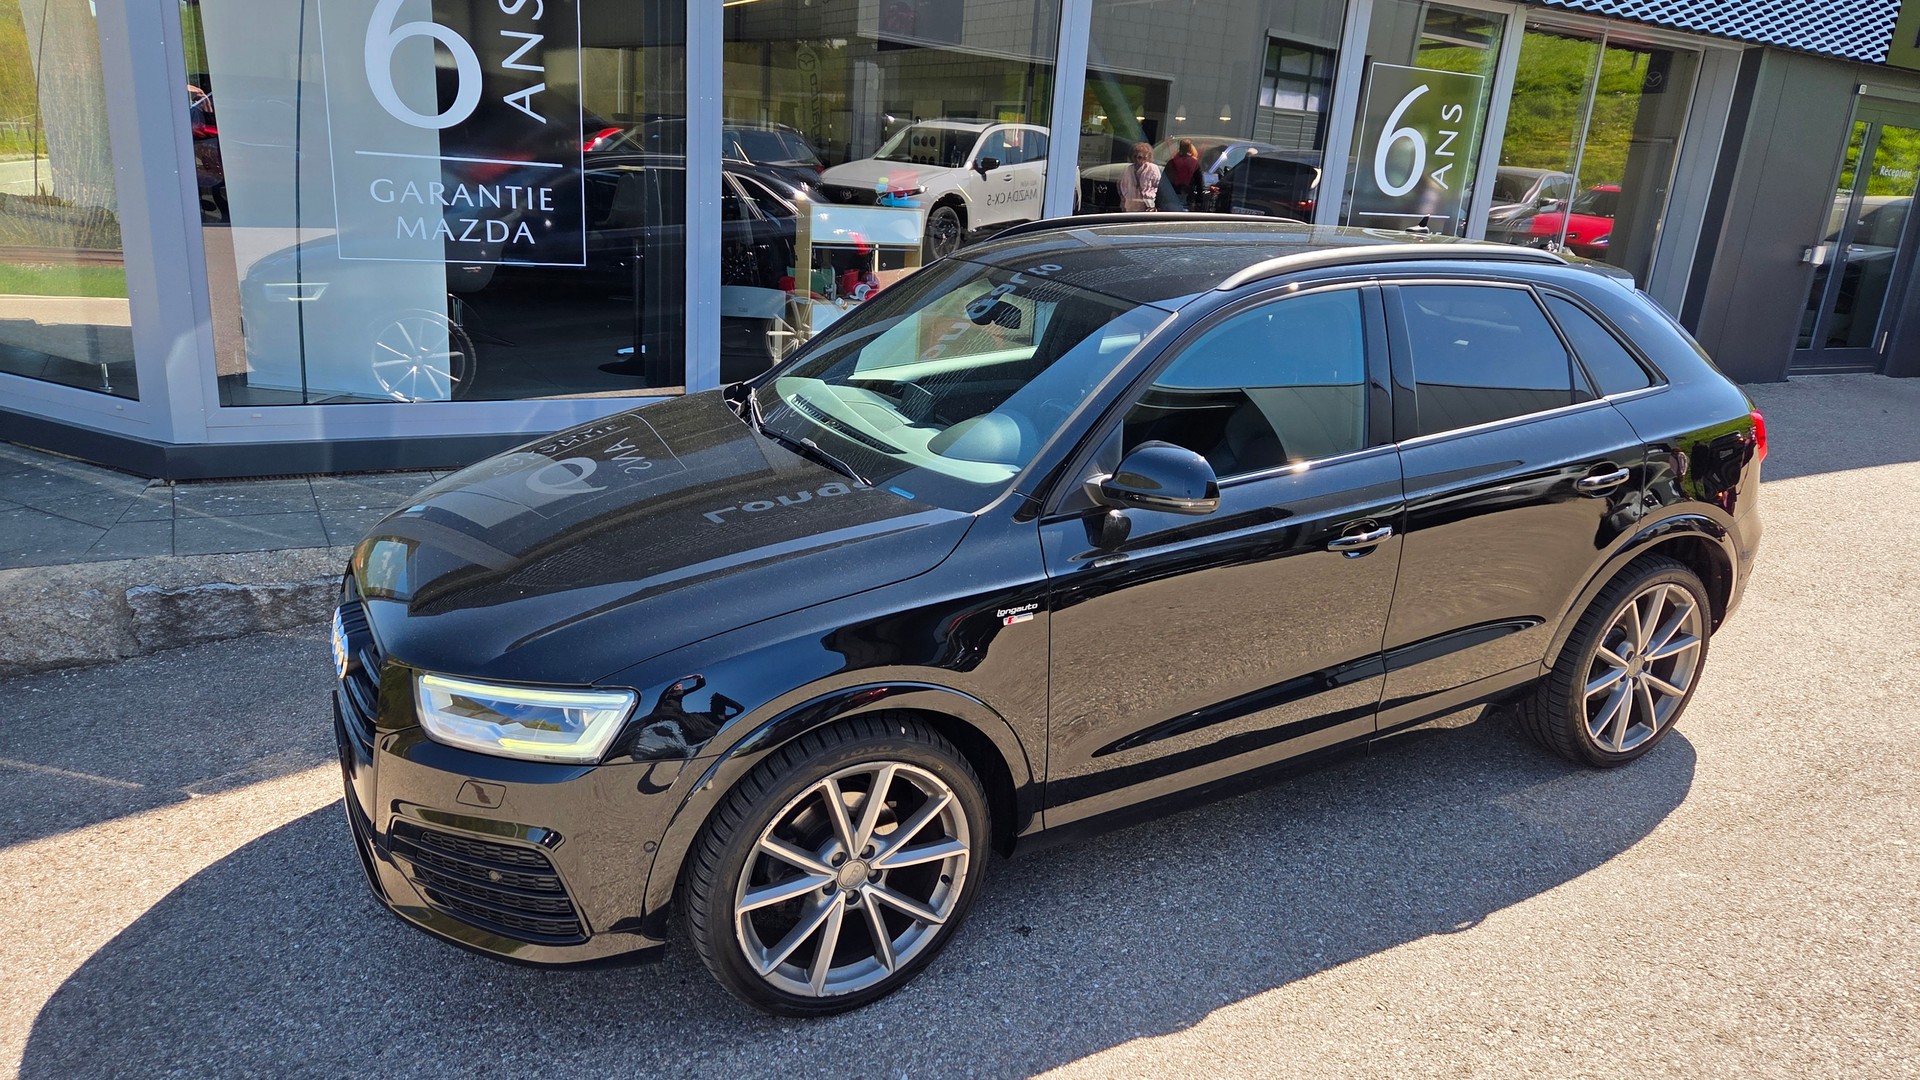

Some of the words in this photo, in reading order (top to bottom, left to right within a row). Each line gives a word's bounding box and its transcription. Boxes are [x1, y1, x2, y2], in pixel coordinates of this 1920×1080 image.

[364, 0, 483, 129] 6
[499, 0, 547, 124] ANS
[1374, 84, 1429, 197] 6
[1431, 104, 1463, 190] ANS
[1880, 165, 1913, 178] Réception
[370, 178, 555, 211] GARANTIE
[396, 215, 536, 245] MAZDA
